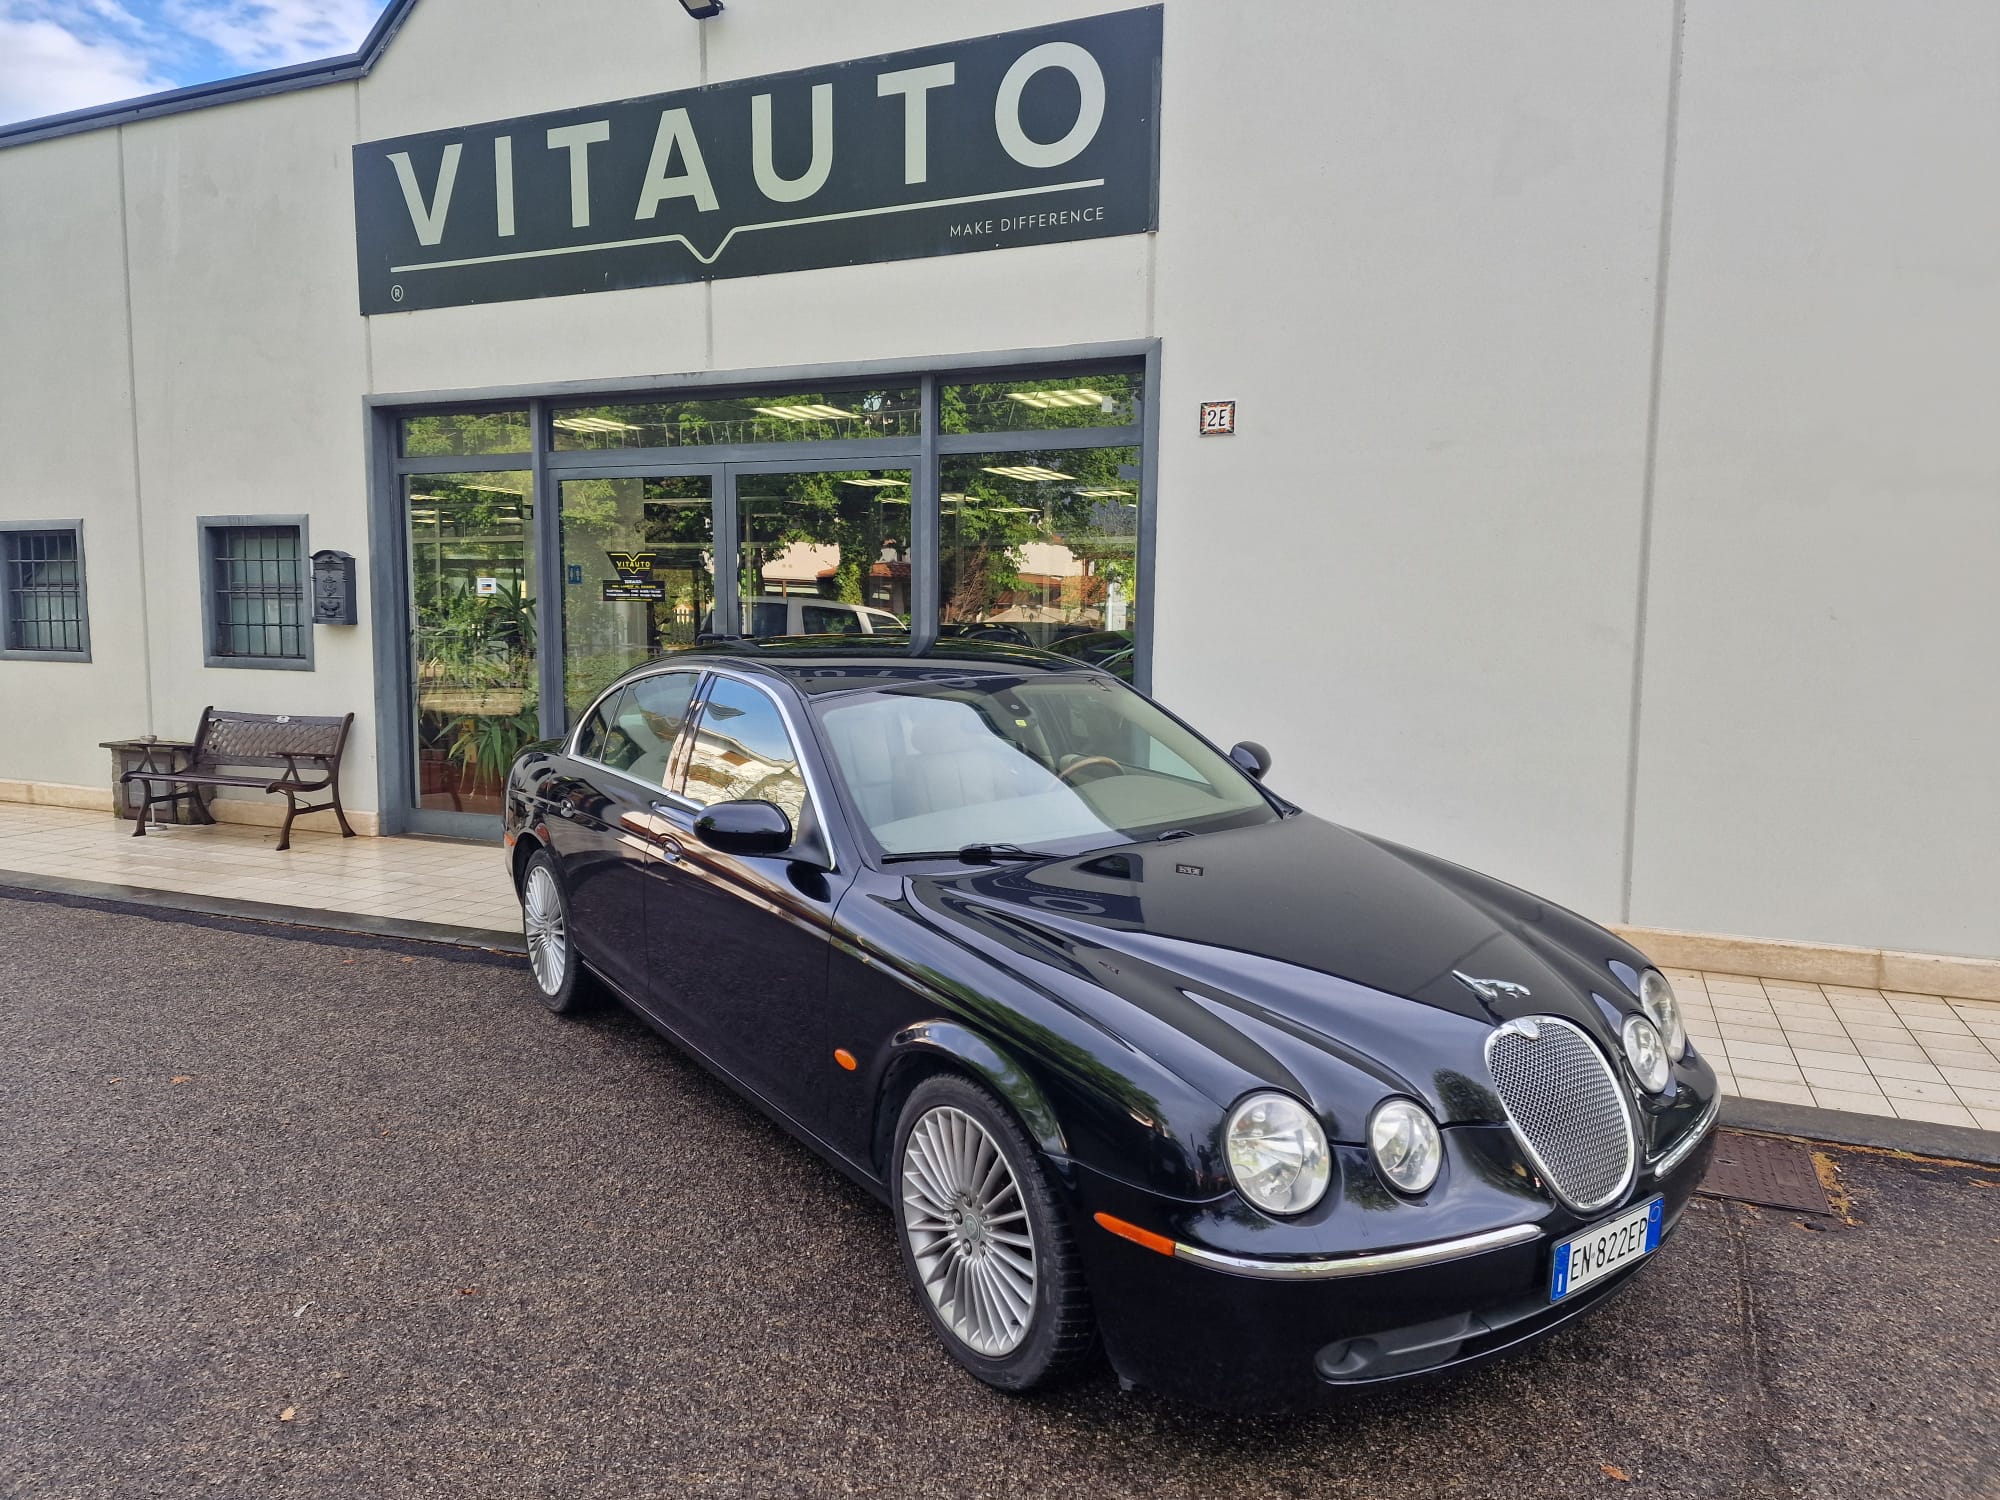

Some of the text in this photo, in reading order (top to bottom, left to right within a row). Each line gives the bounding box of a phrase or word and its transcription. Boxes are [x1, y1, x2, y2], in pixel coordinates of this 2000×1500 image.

[386, 42, 1106, 247] VITAUTO
[950, 206, 1105, 238] MAKE DIFFERENCE
[1207, 409, 1227, 427] 2E
